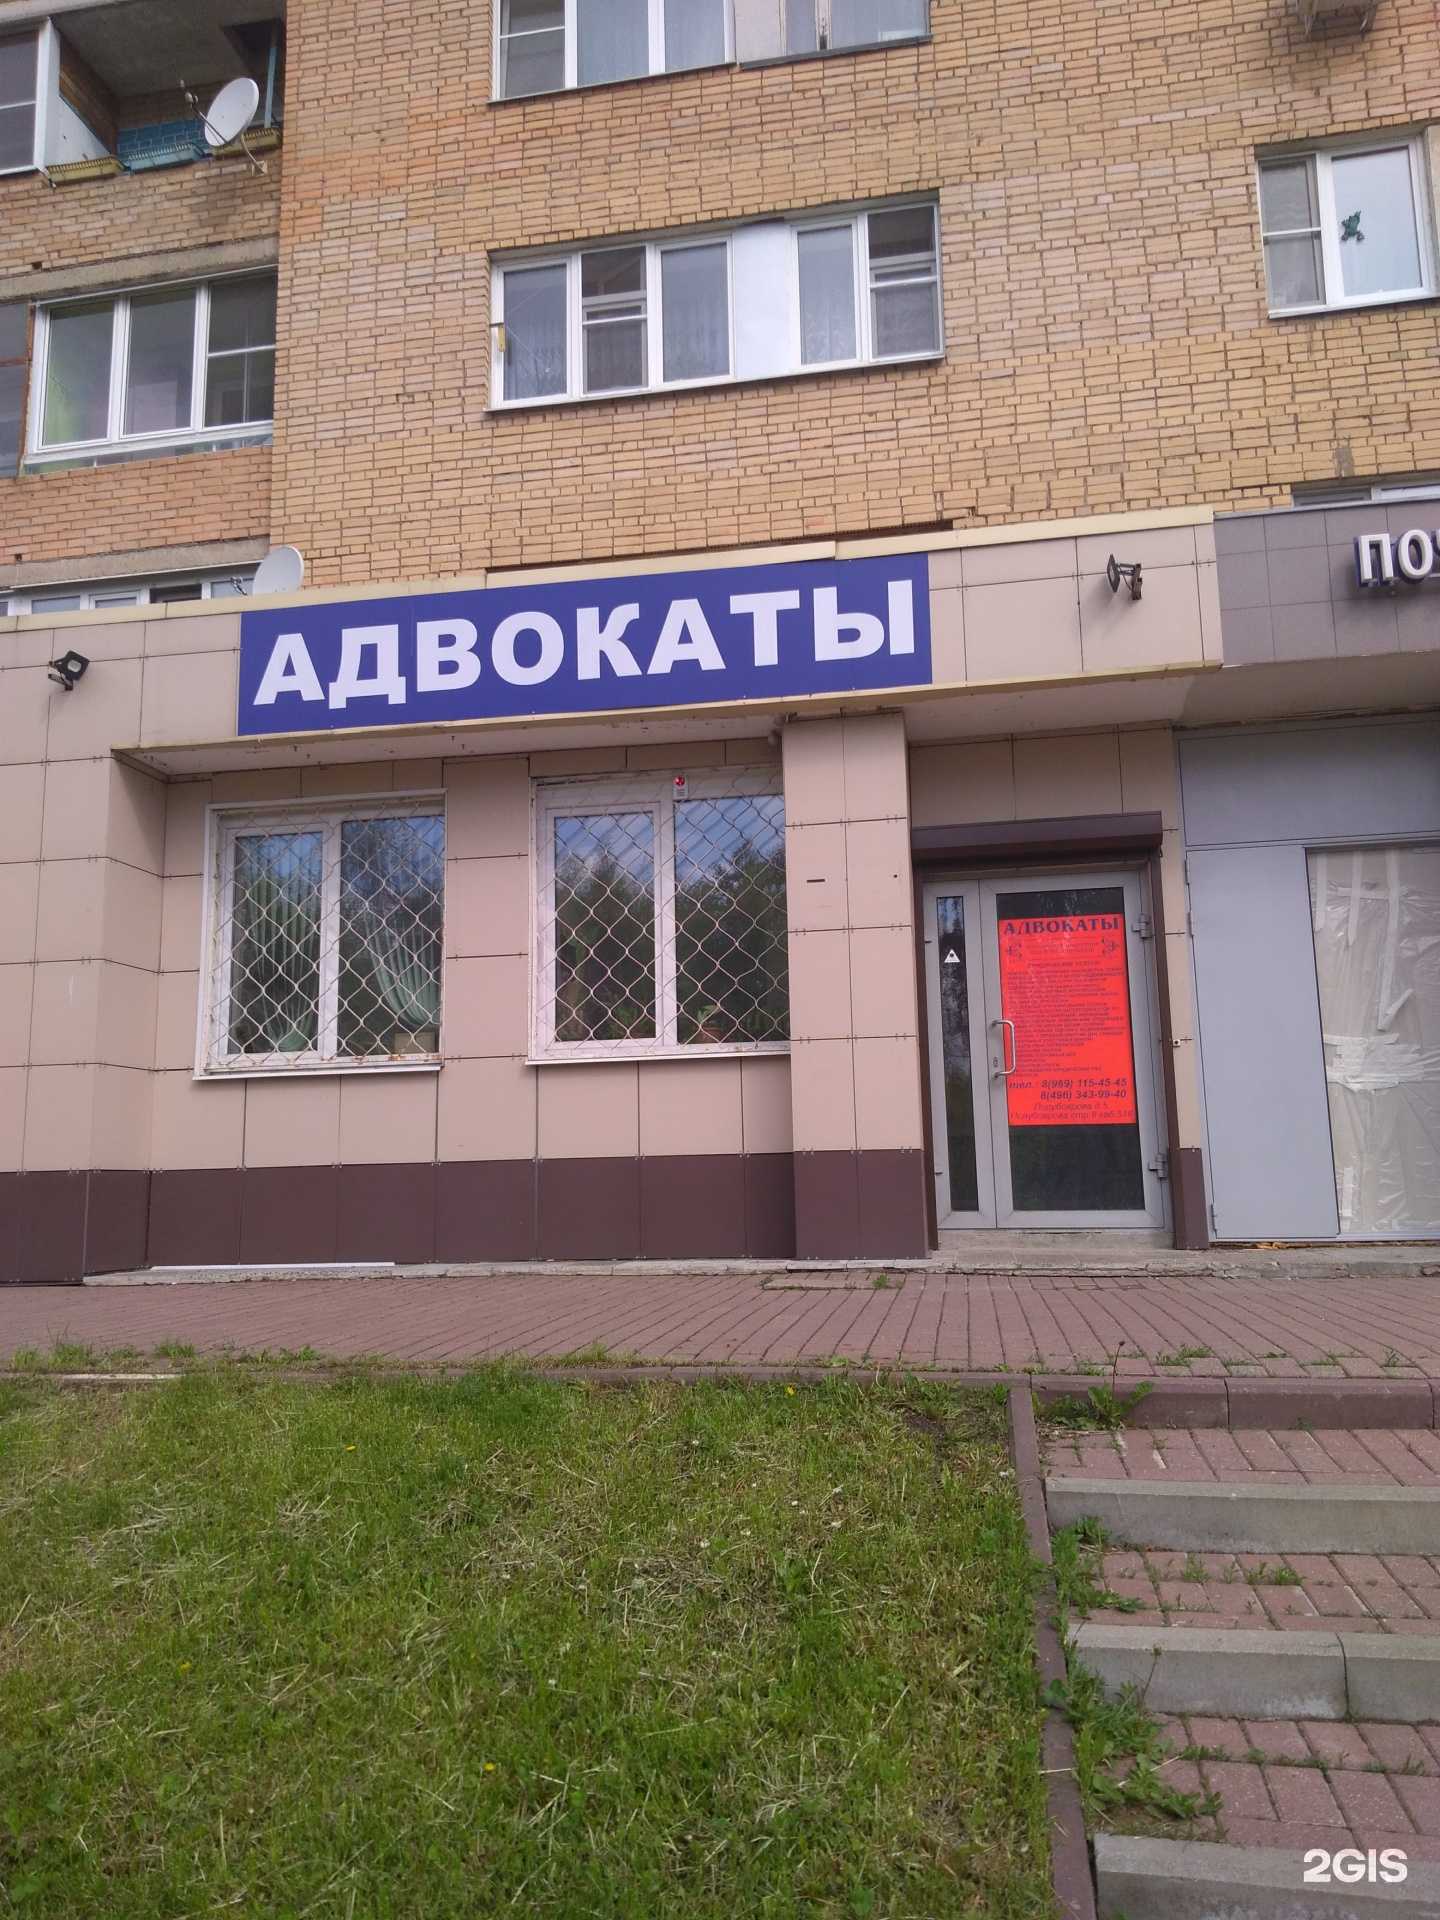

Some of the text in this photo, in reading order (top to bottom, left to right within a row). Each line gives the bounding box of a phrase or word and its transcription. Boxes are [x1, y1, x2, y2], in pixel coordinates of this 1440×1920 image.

[1357, 529, 1440, 582] ПО
[253, 579, 914, 709] АДВОКАТЫ
[1003, 917, 1120, 935] АДВОКАТЫ
